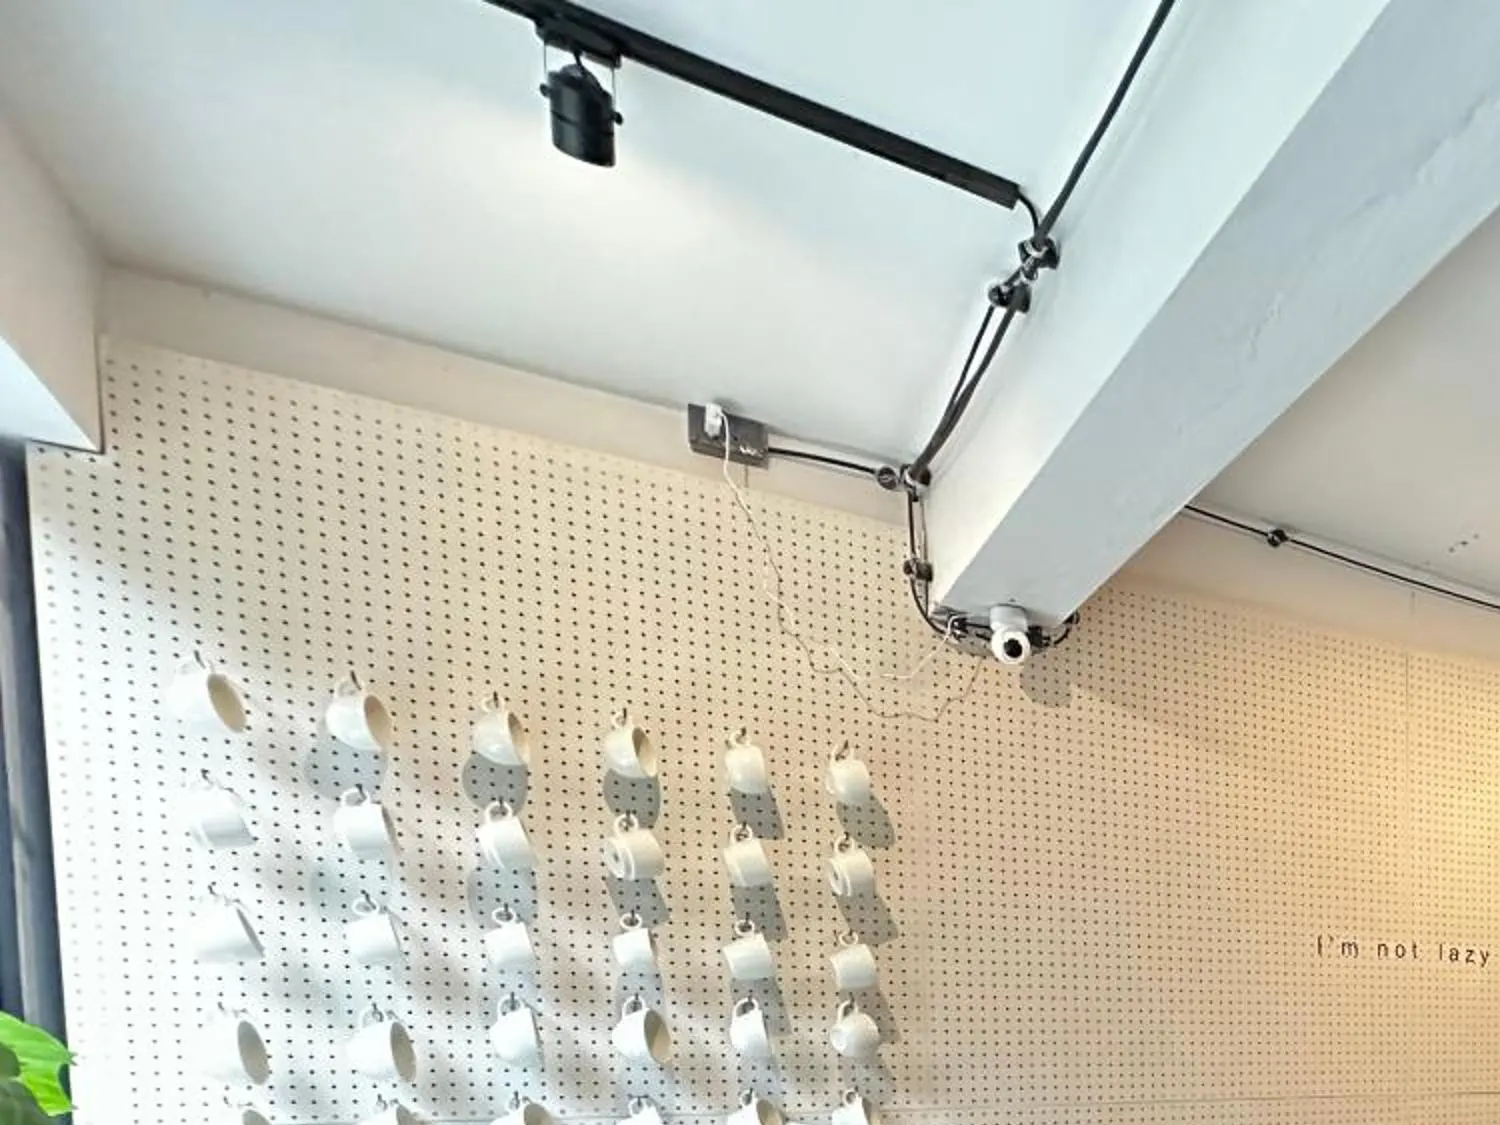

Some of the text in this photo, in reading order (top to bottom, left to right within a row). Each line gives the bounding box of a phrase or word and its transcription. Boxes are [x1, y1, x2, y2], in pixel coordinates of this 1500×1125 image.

[1316, 933, 1490, 967] I'm not lazy
